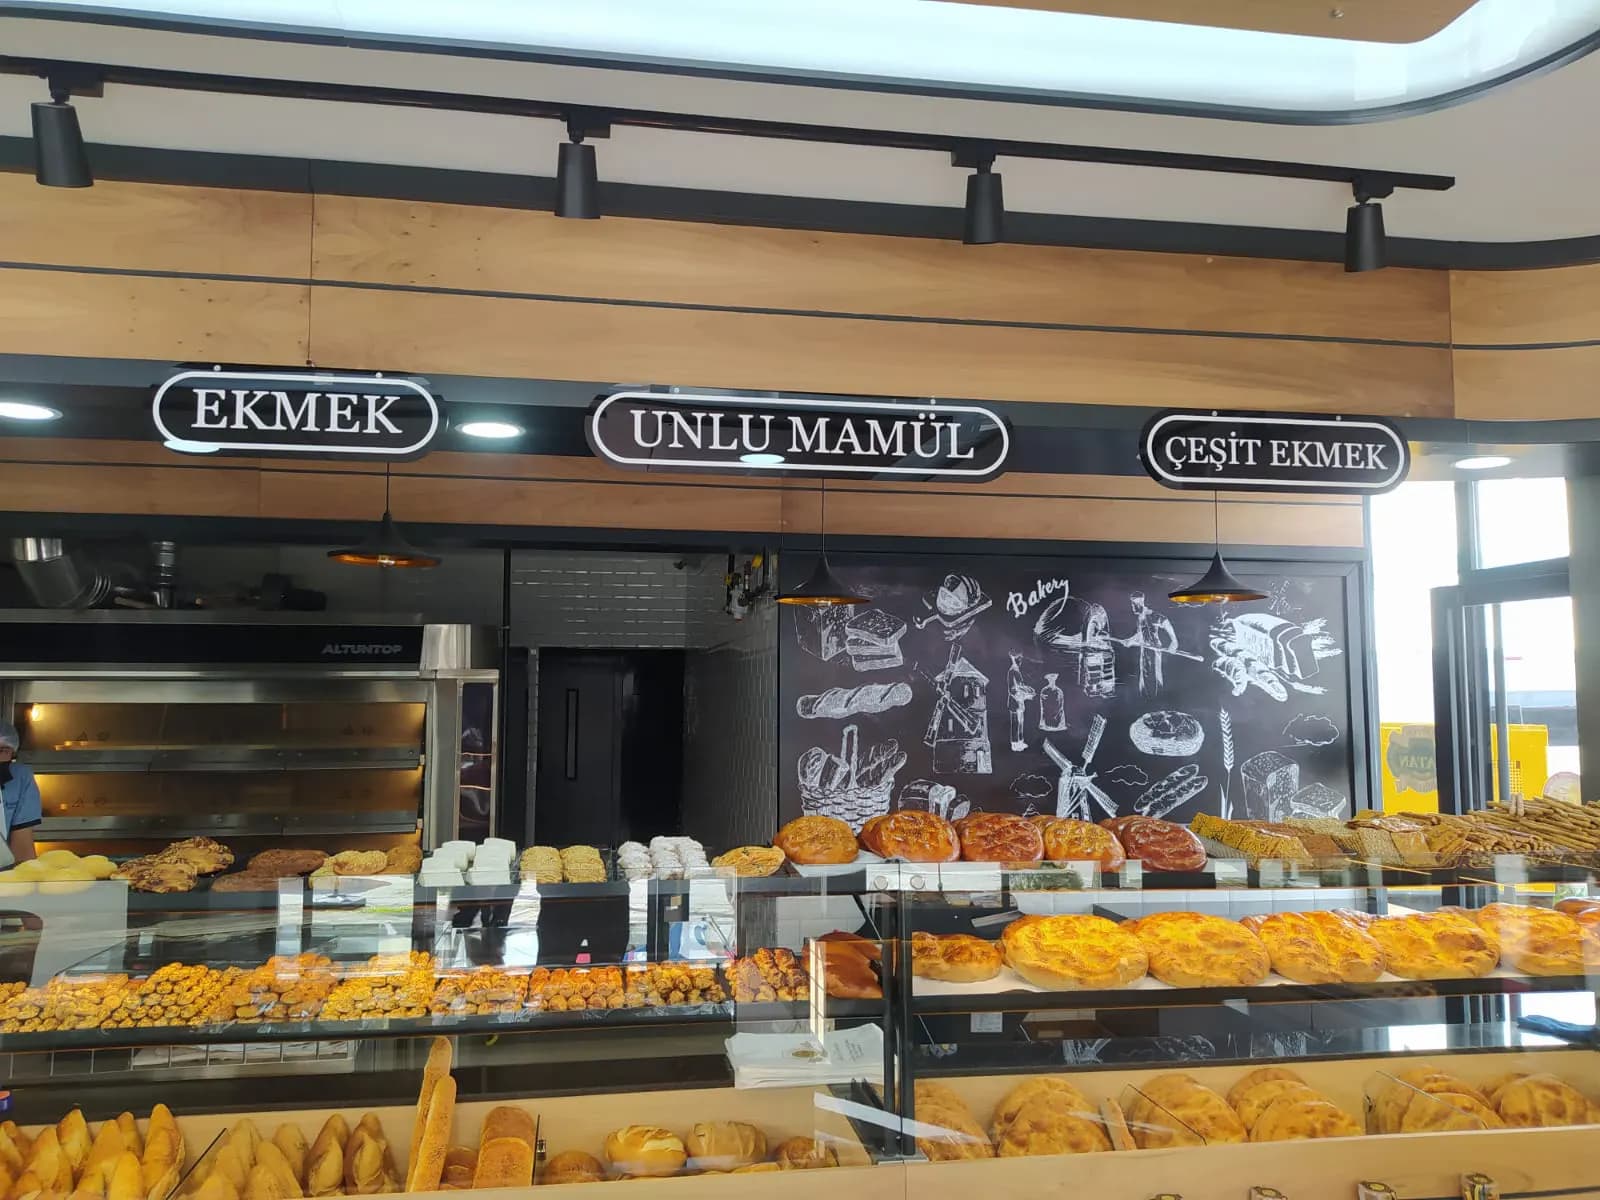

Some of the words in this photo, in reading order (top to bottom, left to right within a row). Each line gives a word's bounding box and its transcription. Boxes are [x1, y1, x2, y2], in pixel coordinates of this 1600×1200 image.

[191, 388, 403, 434] EKMEK
[630, 409, 775, 452] UNLU
[787, 412, 974, 459] MAMÜL
[1165, 431, 1262, 471] ÇEŞİT
[1270, 440, 1388, 470] EKMEK
[1006, 577, 1069, 620] Bakery
[321, 644, 403, 655] ALTUNTOP
